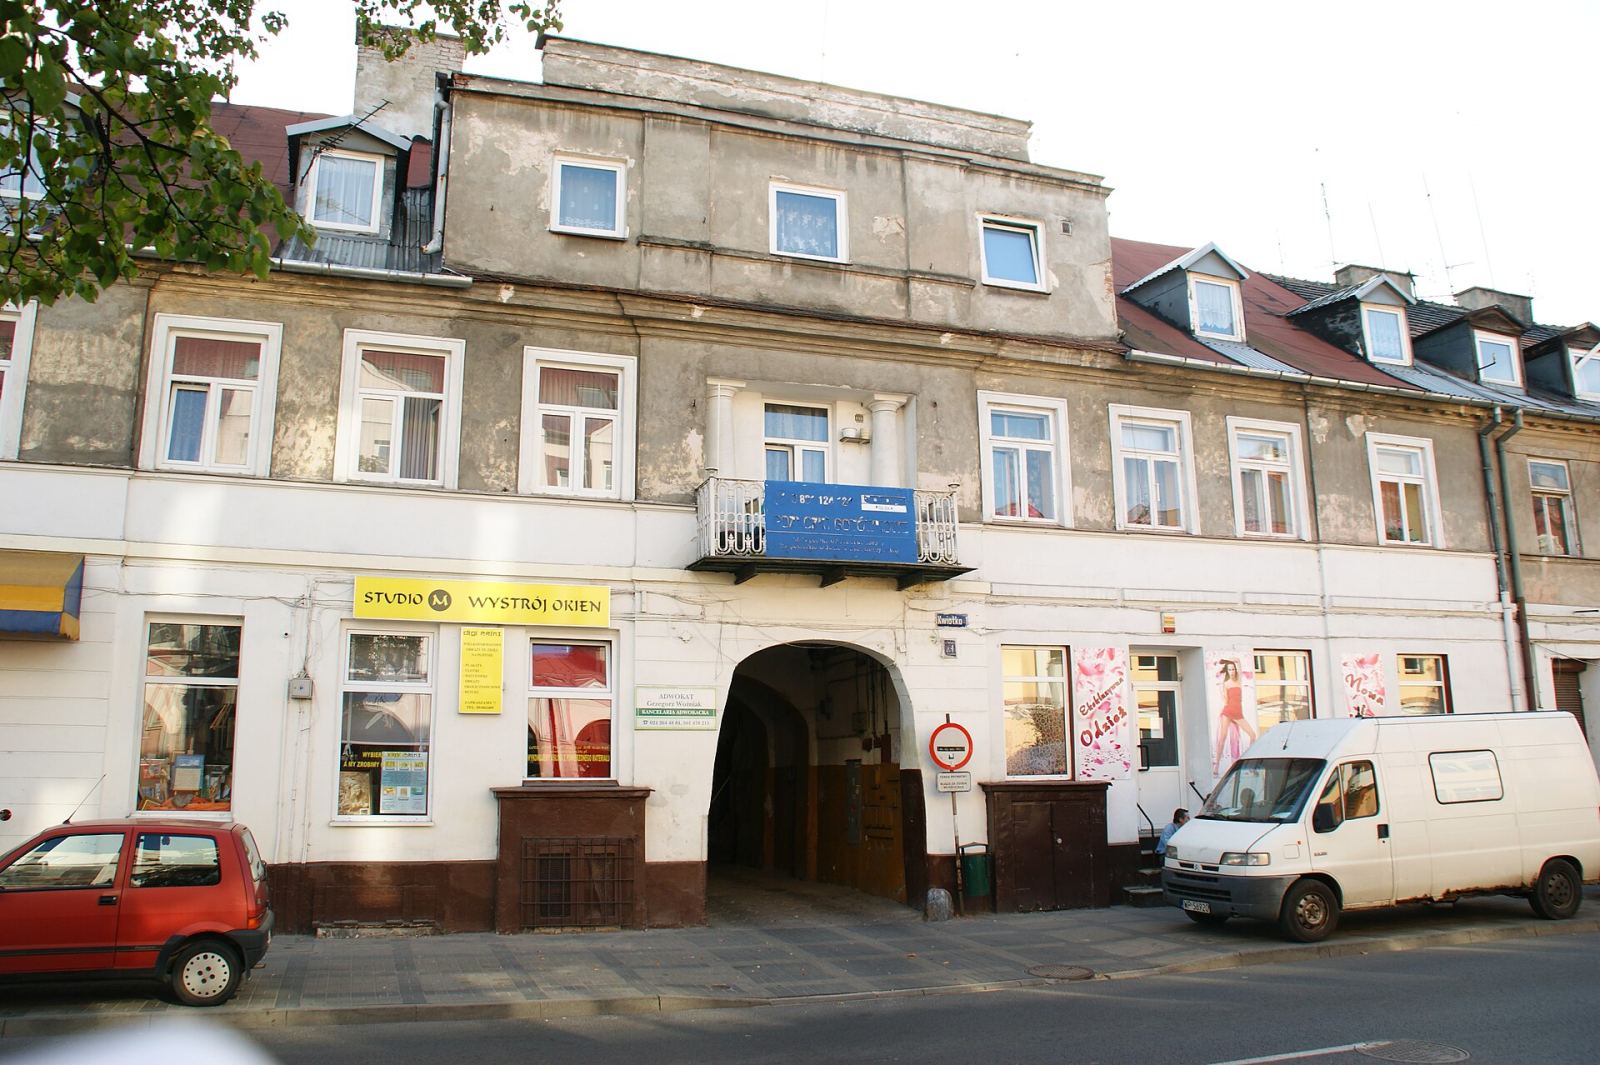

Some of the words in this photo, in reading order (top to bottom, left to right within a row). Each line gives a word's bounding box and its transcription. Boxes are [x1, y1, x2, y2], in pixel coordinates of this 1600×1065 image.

[364, 591, 424, 605] STUDIO
[468, 596, 547, 613] WYSTRÓJ
[552, 599, 601, 612] OKIEN
